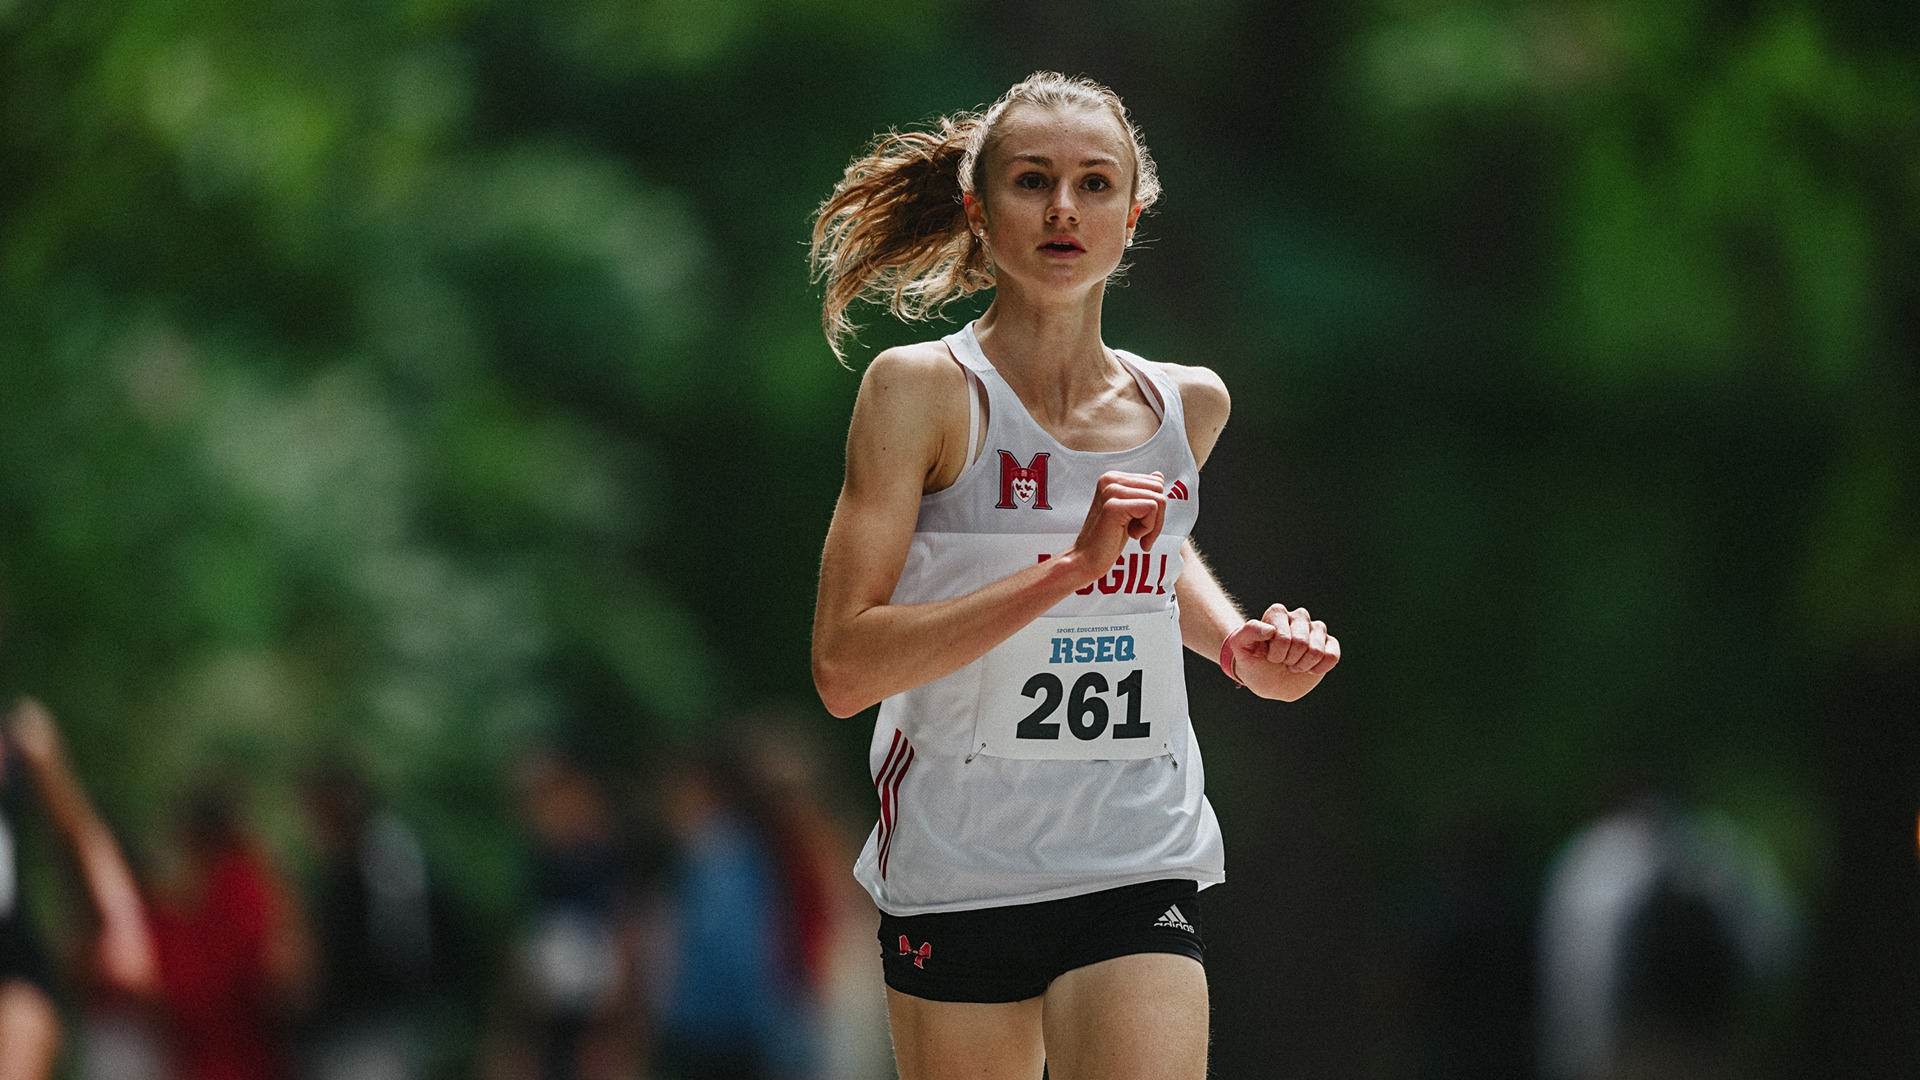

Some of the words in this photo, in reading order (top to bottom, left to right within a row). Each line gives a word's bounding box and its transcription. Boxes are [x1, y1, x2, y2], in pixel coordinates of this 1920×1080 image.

[1038, 553, 1167, 595] GILL
[1049, 635, 1136, 663] RSEQ
[1016, 669, 1151, 741] 261
